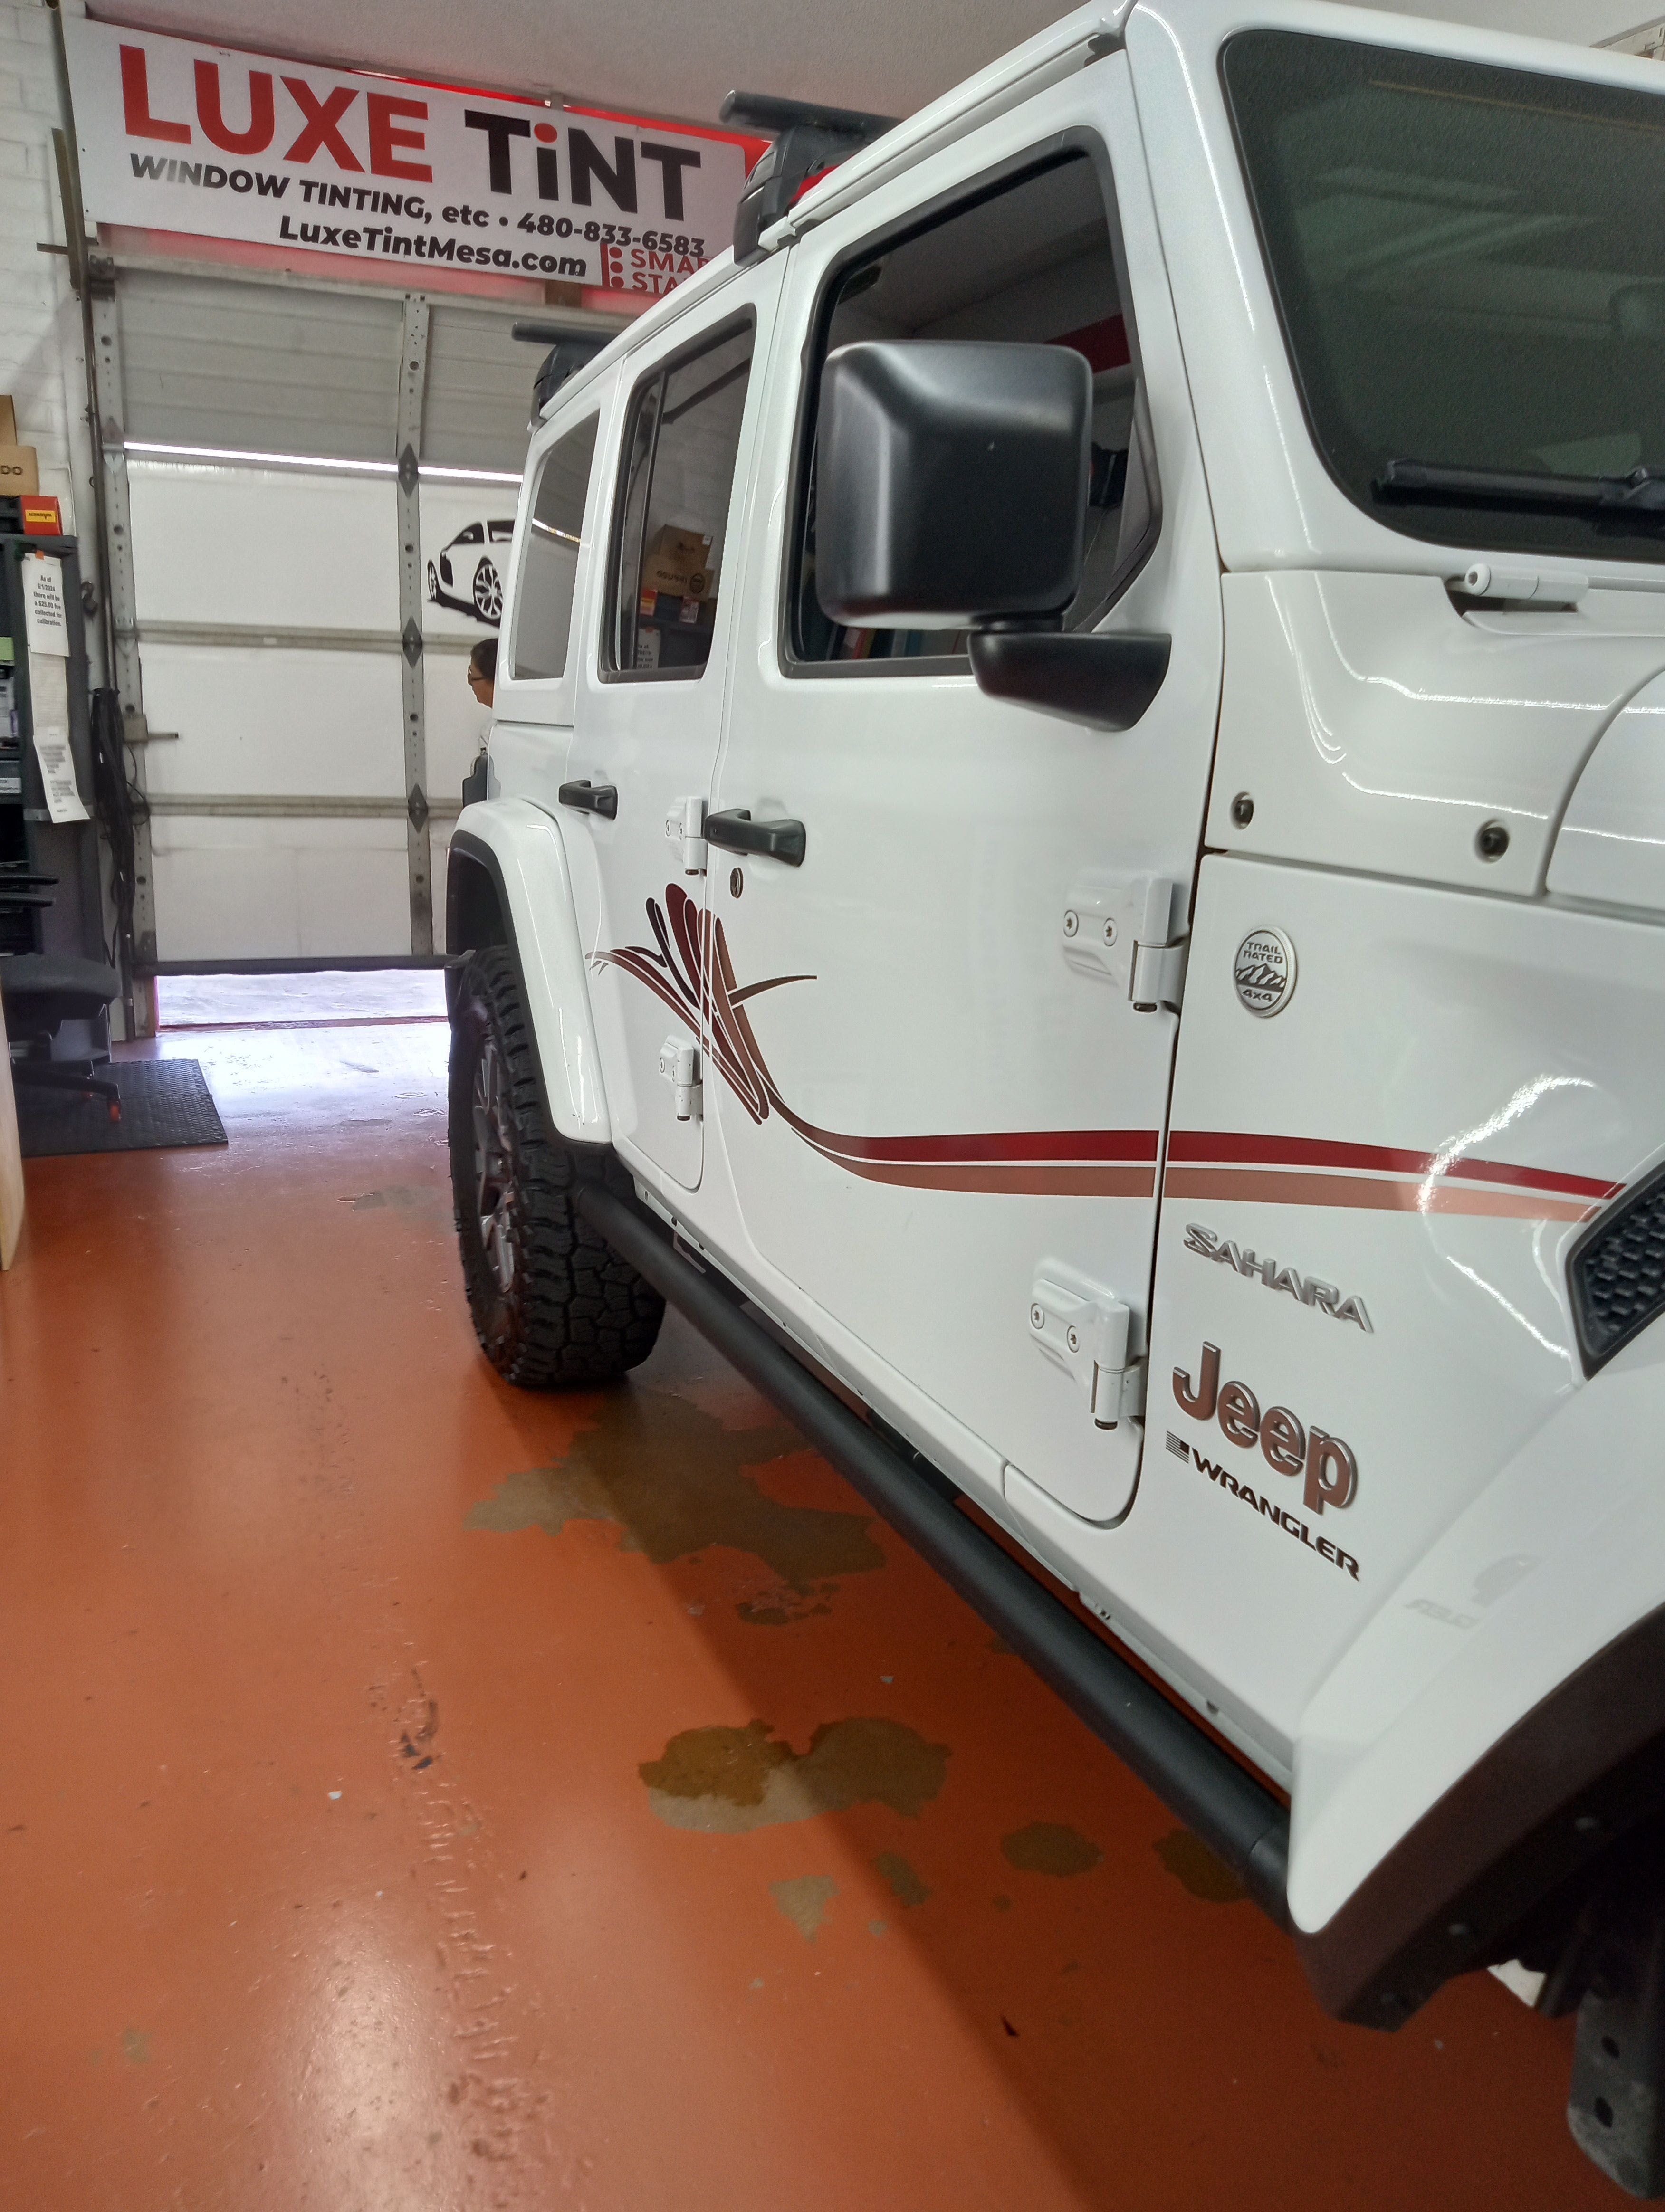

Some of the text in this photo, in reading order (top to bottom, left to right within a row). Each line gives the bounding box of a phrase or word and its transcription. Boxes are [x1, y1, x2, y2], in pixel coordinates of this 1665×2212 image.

[119, 44, 432, 183] LUXE
[130, 153, 705, 257] WINDOW TINTING, etc 480-833-6583
[279, 215, 587, 277] LuxeTintMesa.com
[37, 582, 56, 592] 6/1/2024
[38, 600, 54, 608] $25.00
[37, 618, 62, 626] calibration.
[1243, 950, 1283, 964] RATED
[1246, 941, 1281, 955] TRAIL
[1183, 1222, 1374, 1334] SAHARA
[1172, 1341, 1359, 1515] Jeep
[1188, 1445, 1360, 1582] WRANGLER
